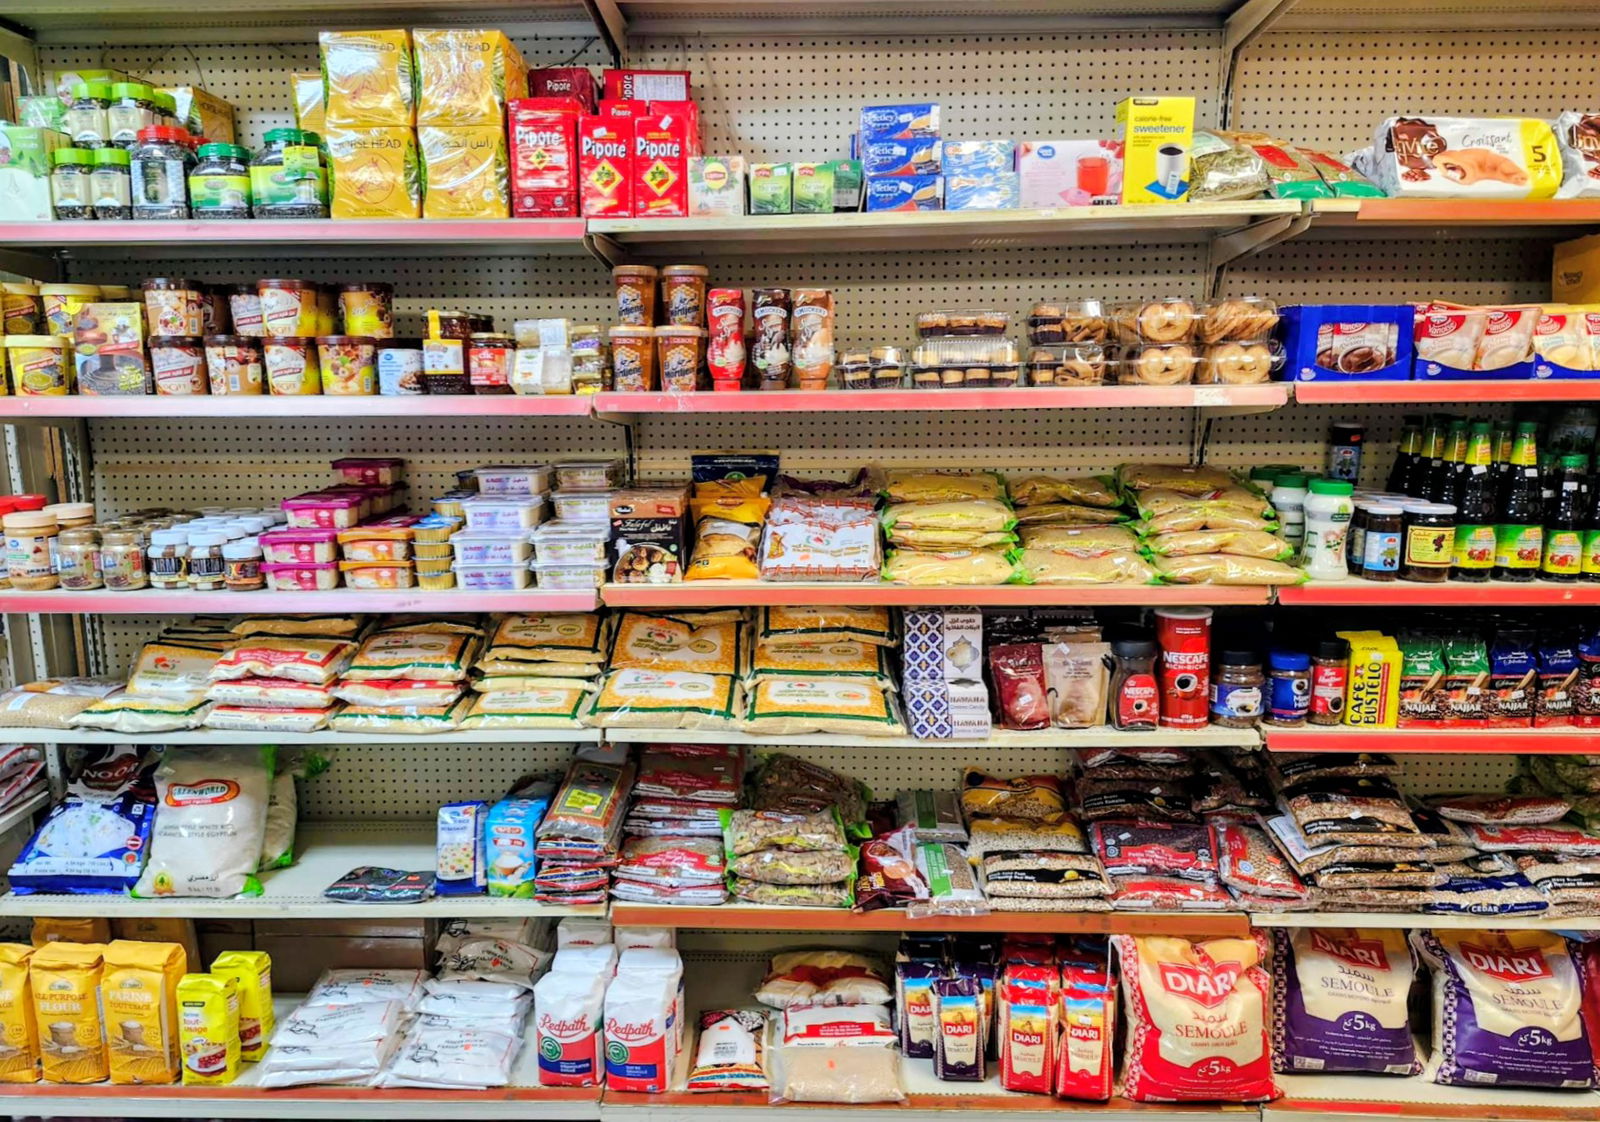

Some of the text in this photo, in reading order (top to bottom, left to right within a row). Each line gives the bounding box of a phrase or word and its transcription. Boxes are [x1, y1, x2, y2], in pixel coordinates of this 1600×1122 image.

[547, 80, 571, 93] Pipore
[1133, 125, 1185, 134] sweetener
[371, 139, 401, 149] HEAD
[516, 127, 561, 148] Pipore
[1461, 132, 1513, 148] Croissant
[582, 137, 627, 158] Pipore
[636, 137, 681, 158] Pipore
[1532, 146, 1545, 162] 5
[1363, 661, 1383, 725] BUSTELO
[1405, 703, 1438, 715] NAJJAR
[1450, 702, 1482, 714] NAJJAR
[1498, 700, 1528, 713] NAJJAR
[1546, 699, 1572, 711] NAJJAR
[1470, 903, 1499, 913] CEDAR
[1315, 933, 1381, 967] DIARI
[1470, 953, 1543, 975] DIARI
[1165, 972, 1238, 997] DIARI
[1320, 976, 1394, 998] SEMOULE
[109, 991, 153, 1003] FARINE
[1492, 993, 1561, 1010] SEMOULE
[40, 1002, 81, 1012] FLOUR
[184, 1026, 208, 1034] usage
[540, 1013, 591, 1038] Redpath
[607, 1017, 657, 1041] Redpath
[946, 1025, 972, 1034] DIARI
[1175, 1021, 1248, 1039] SEMOULE
[1014, 1033, 1041, 1044] DIARI
[1071, 1028, 1098, 1039] DIARI
